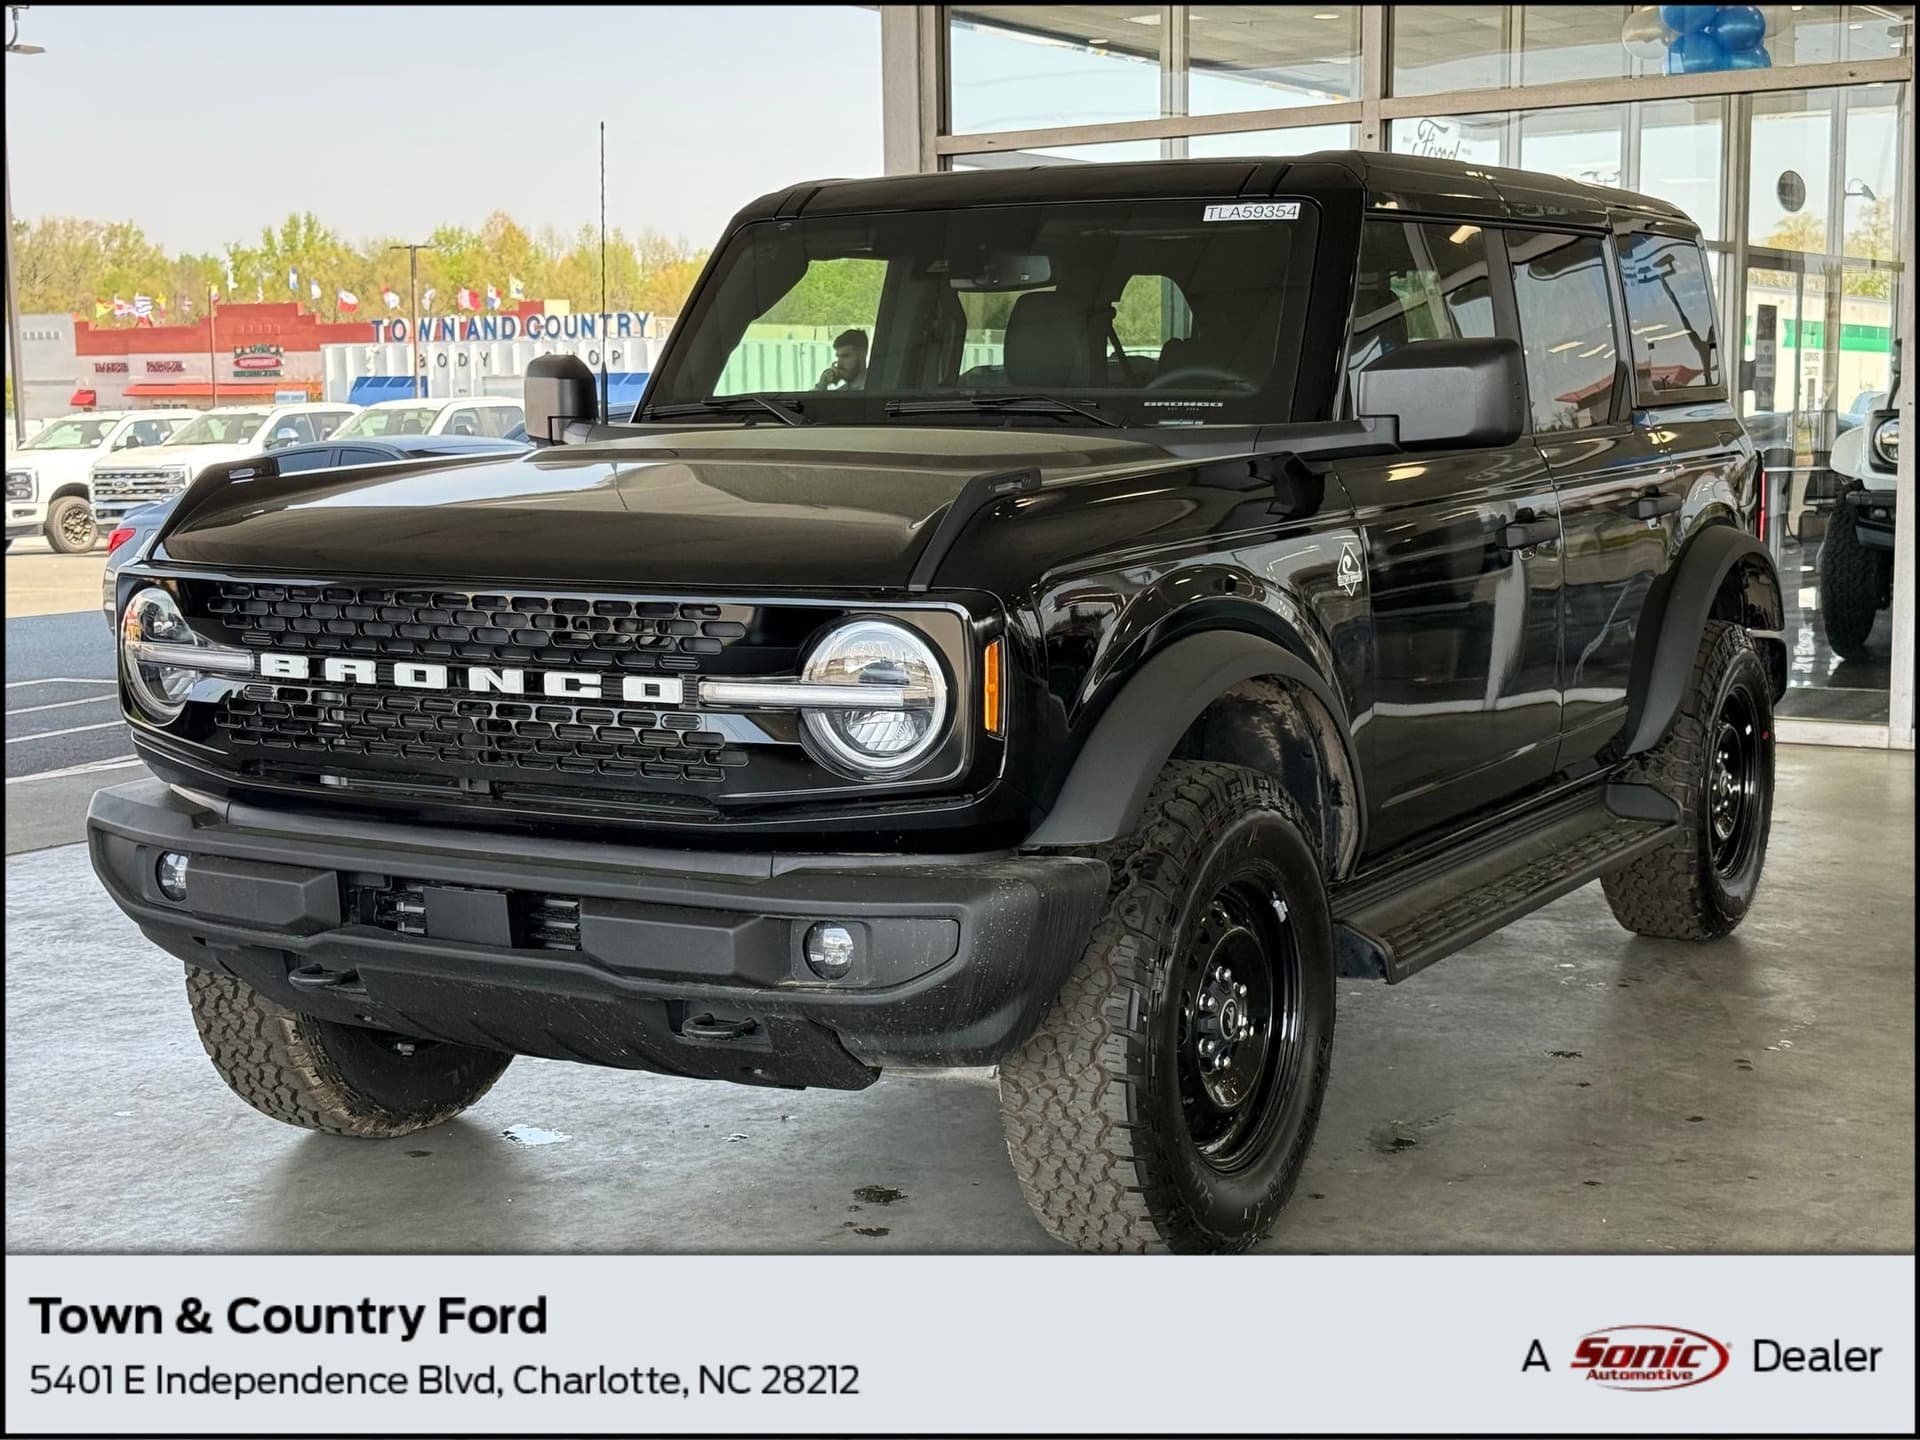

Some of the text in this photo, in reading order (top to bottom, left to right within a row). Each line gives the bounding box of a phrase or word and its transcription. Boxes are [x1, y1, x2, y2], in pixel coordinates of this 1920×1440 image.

[1207, 204, 1298, 220] TLA59354
[371, 312, 651, 342] TOWN AND COUNTRY
[418, 350, 622, 368] BODY OP
[260, 652, 683, 704] BRONCO
